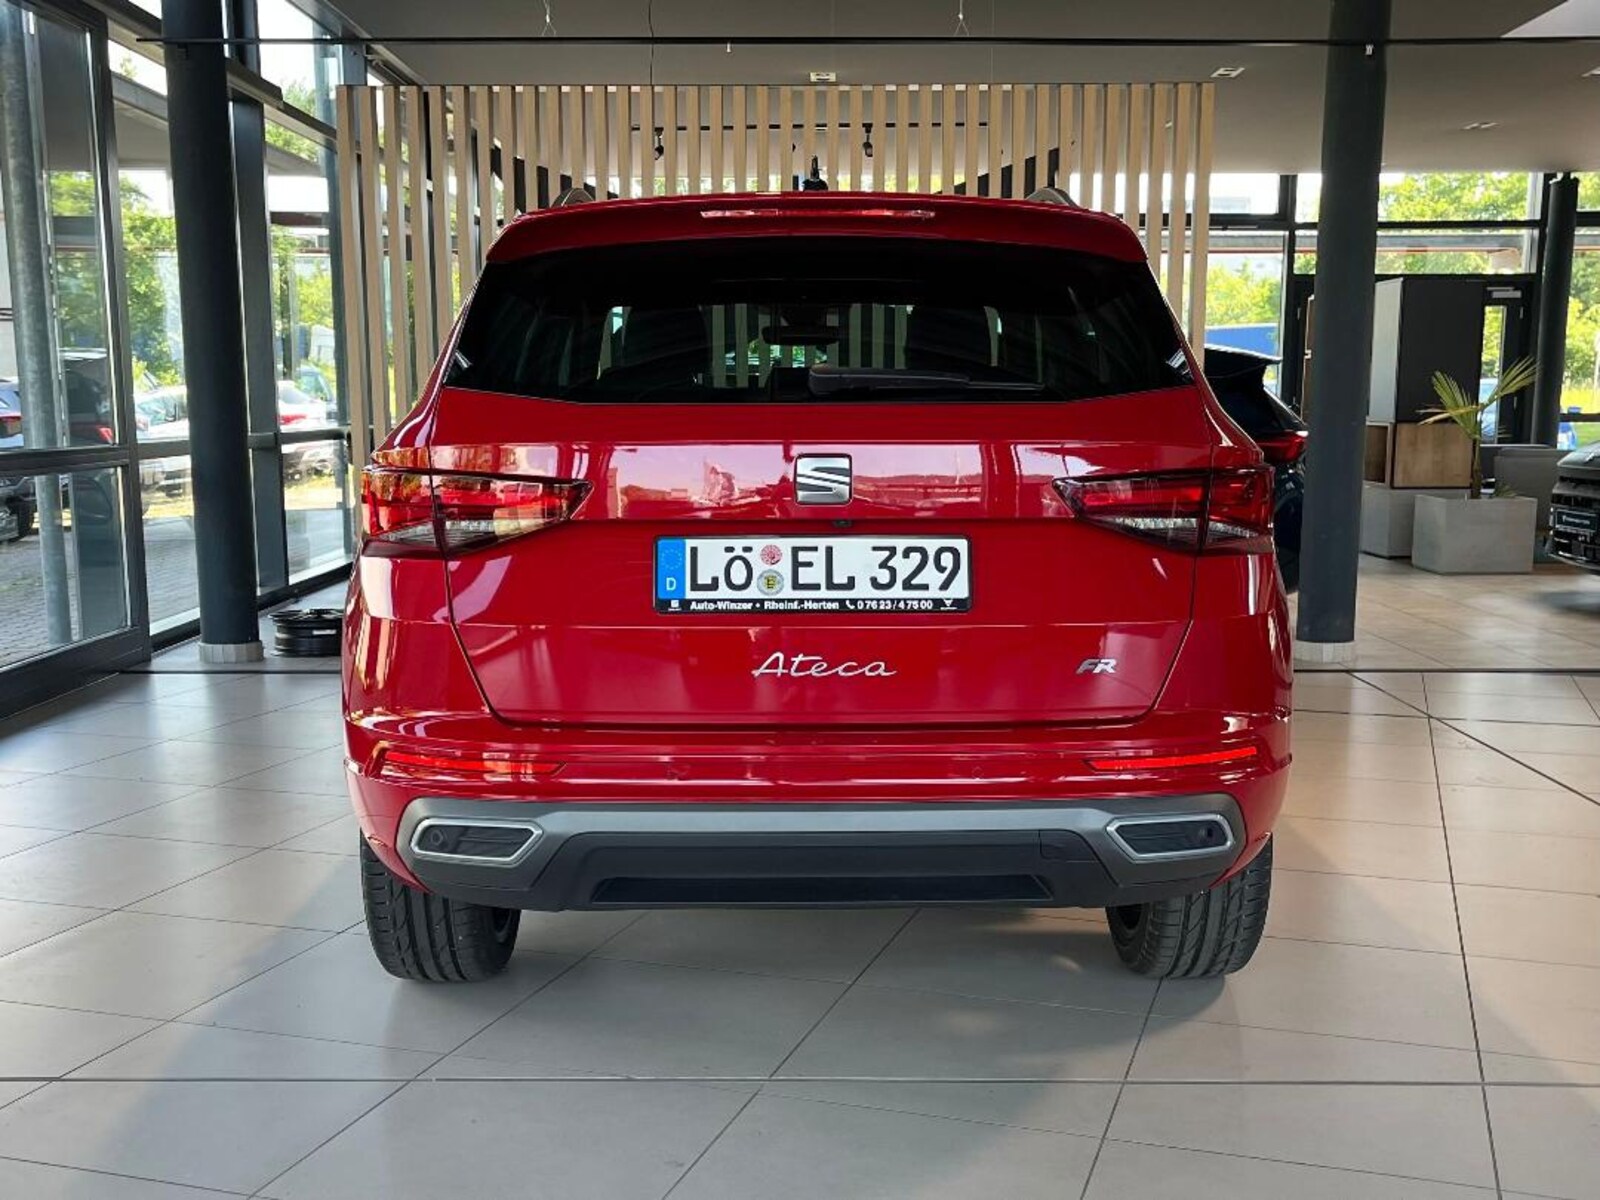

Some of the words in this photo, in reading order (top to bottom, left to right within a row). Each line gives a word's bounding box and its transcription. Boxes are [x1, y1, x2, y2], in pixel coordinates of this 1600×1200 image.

[689, 546, 754, 592] LÖ
[791, 545, 856, 591] EL
[869, 545, 961, 591] 329
[666, 577, 677, 590] D
[689, 600, 753, 611] Auto-Winzer
[751, 651, 897, 678] Ateca
[1075, 658, 1117, 675] FR
